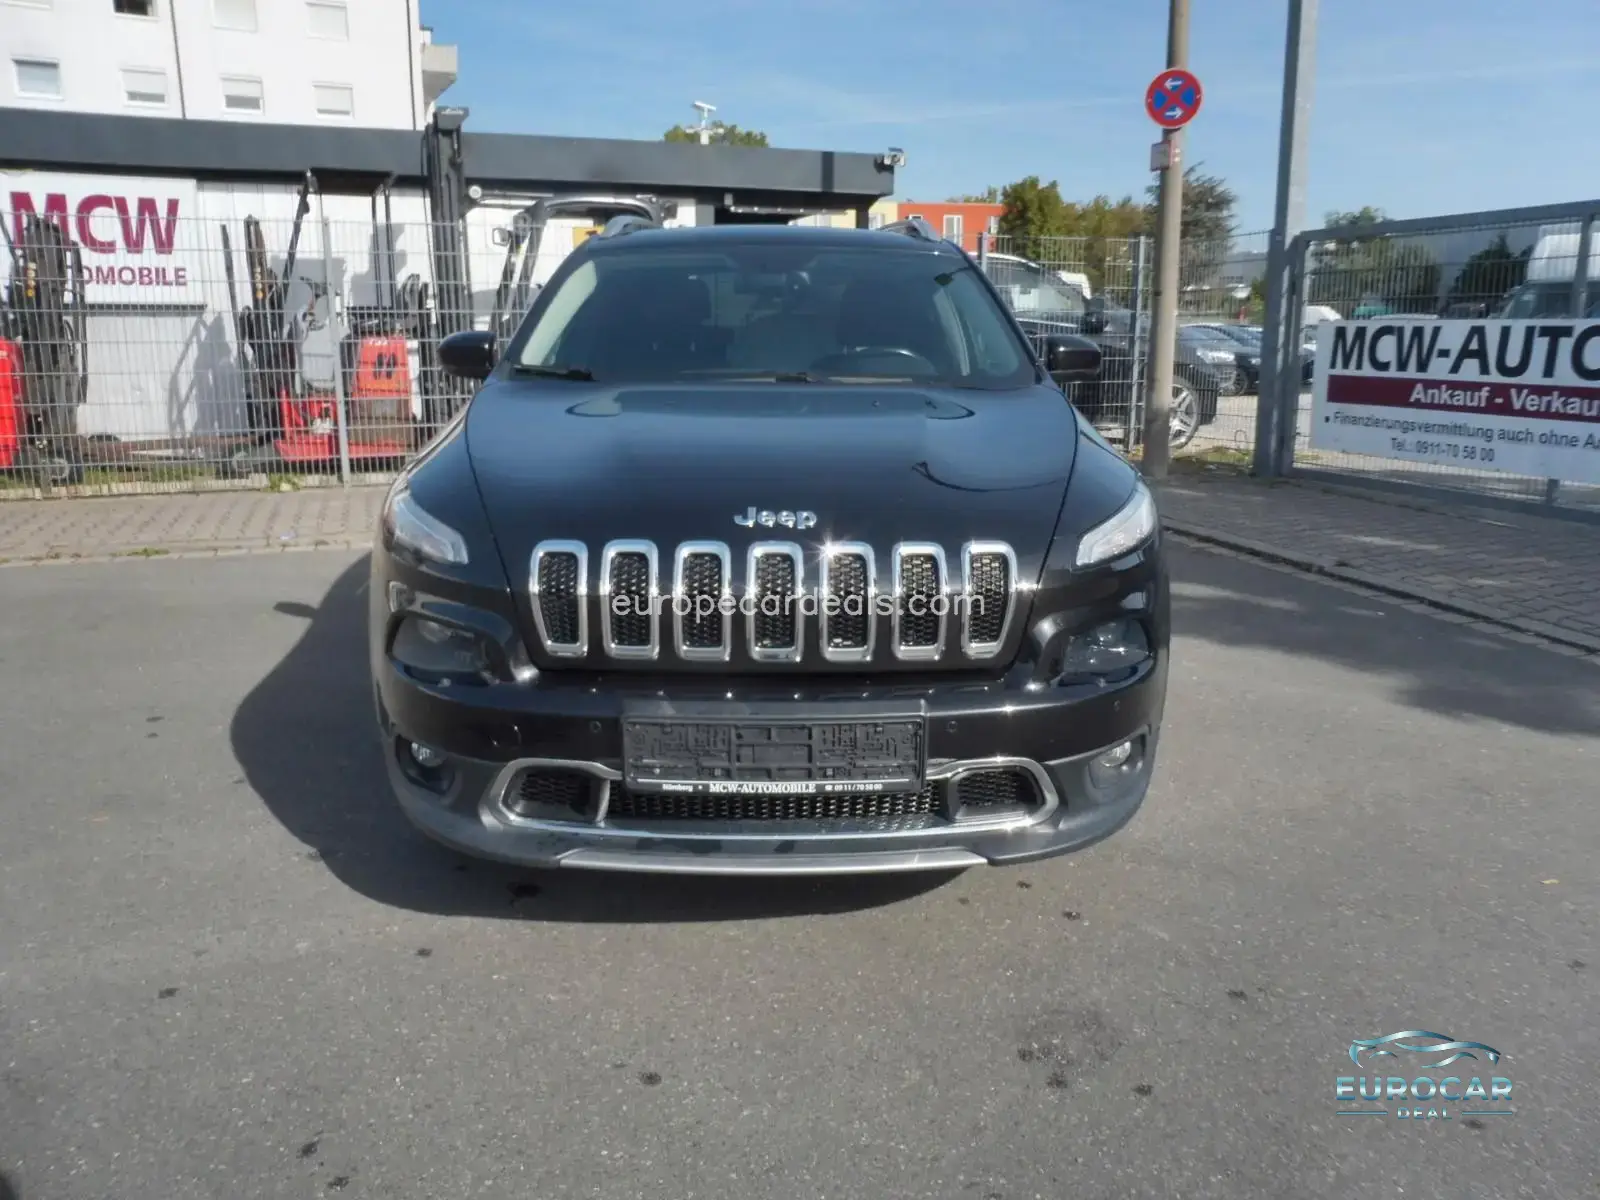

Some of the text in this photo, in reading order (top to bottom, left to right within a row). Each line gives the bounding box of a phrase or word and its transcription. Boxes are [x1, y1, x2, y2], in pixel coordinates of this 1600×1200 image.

[10, 191, 180, 255] MCW
[1329, 324, 1600, 382] MCW-AUTO
[1409, 383, 1491, 408] Ankauf
[1333, 411, 1494, 443] Finanzierungsvermittlung
[1497, 428, 1533, 444] auch
[1539, 429, 1580, 447] ohne
[1463, 445, 1477, 460] 58
[1480, 447, 1495, 462] 00
[734, 506, 817, 529] Jeep
[709, 783, 816, 793] MCW-AUTOMOBILE
